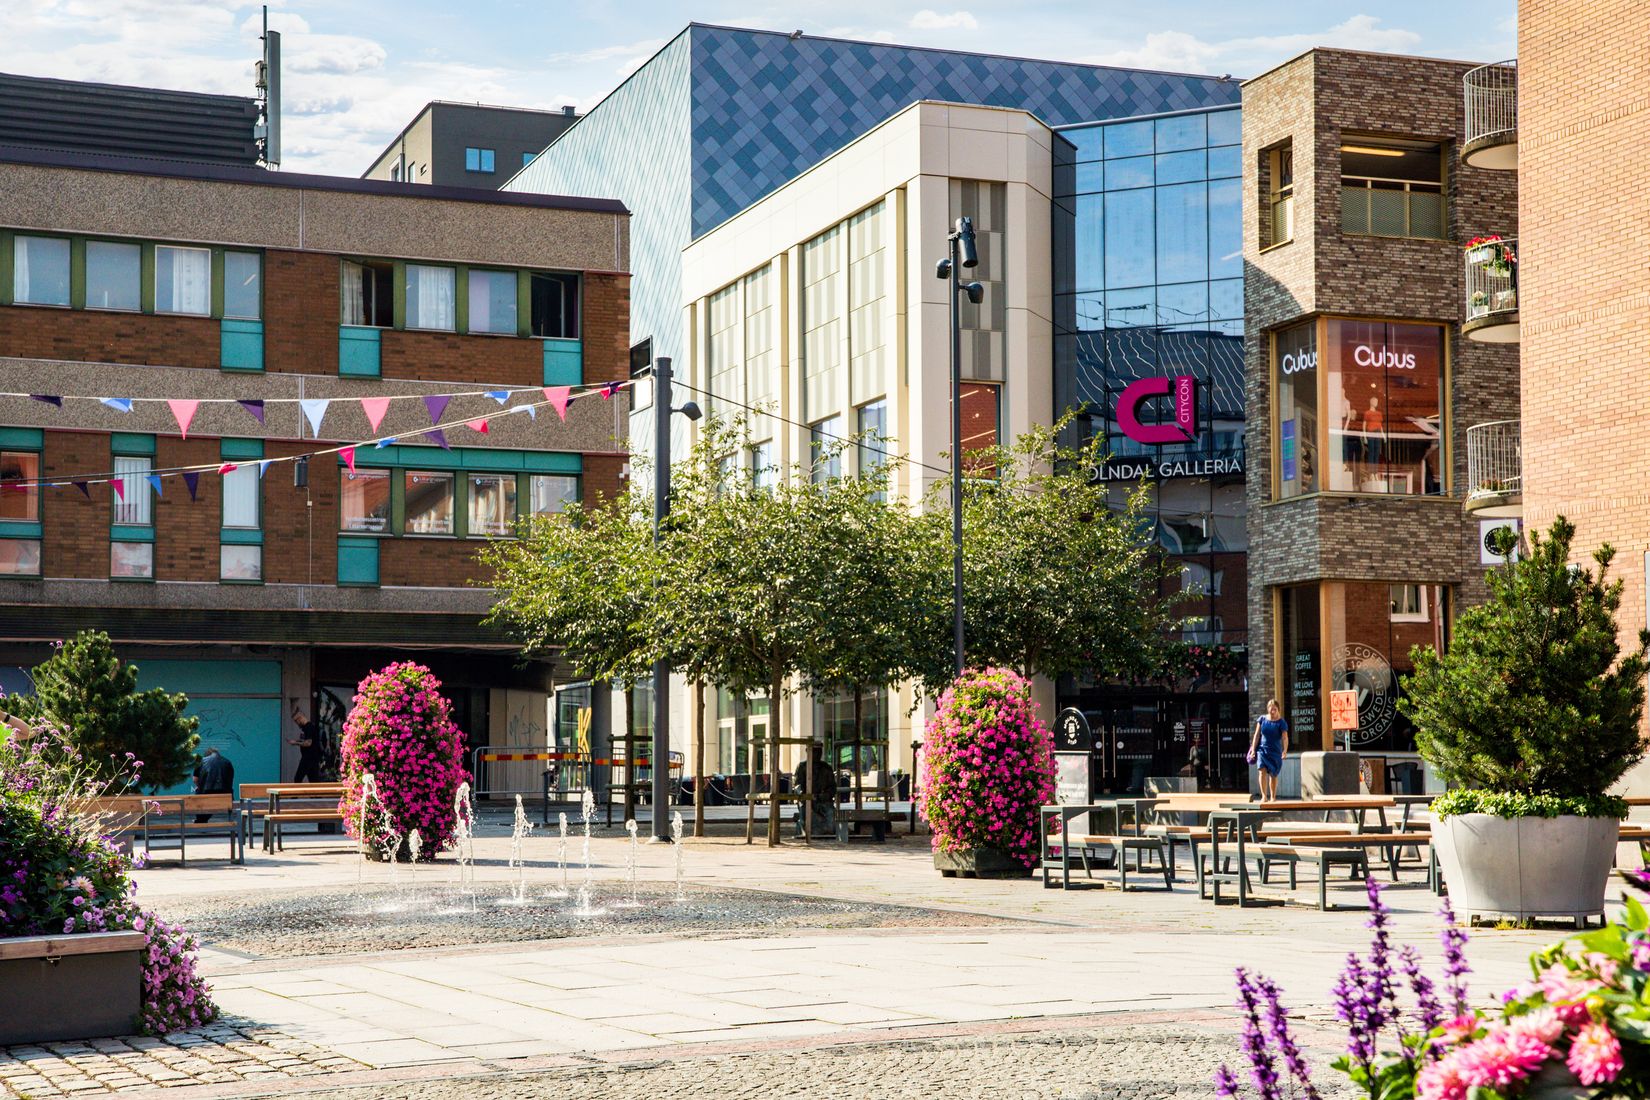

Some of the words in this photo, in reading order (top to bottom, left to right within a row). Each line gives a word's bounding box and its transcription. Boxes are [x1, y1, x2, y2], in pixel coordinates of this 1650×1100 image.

[1354, 345, 1416, 369] Cubus
[1180, 379, 1190, 423] CITYCON
[1158, 458, 1242, 478] GALLERIA
[1302, 680, 1314, 689] LOVE
[1294, 716, 1310, 724] LUNCH
